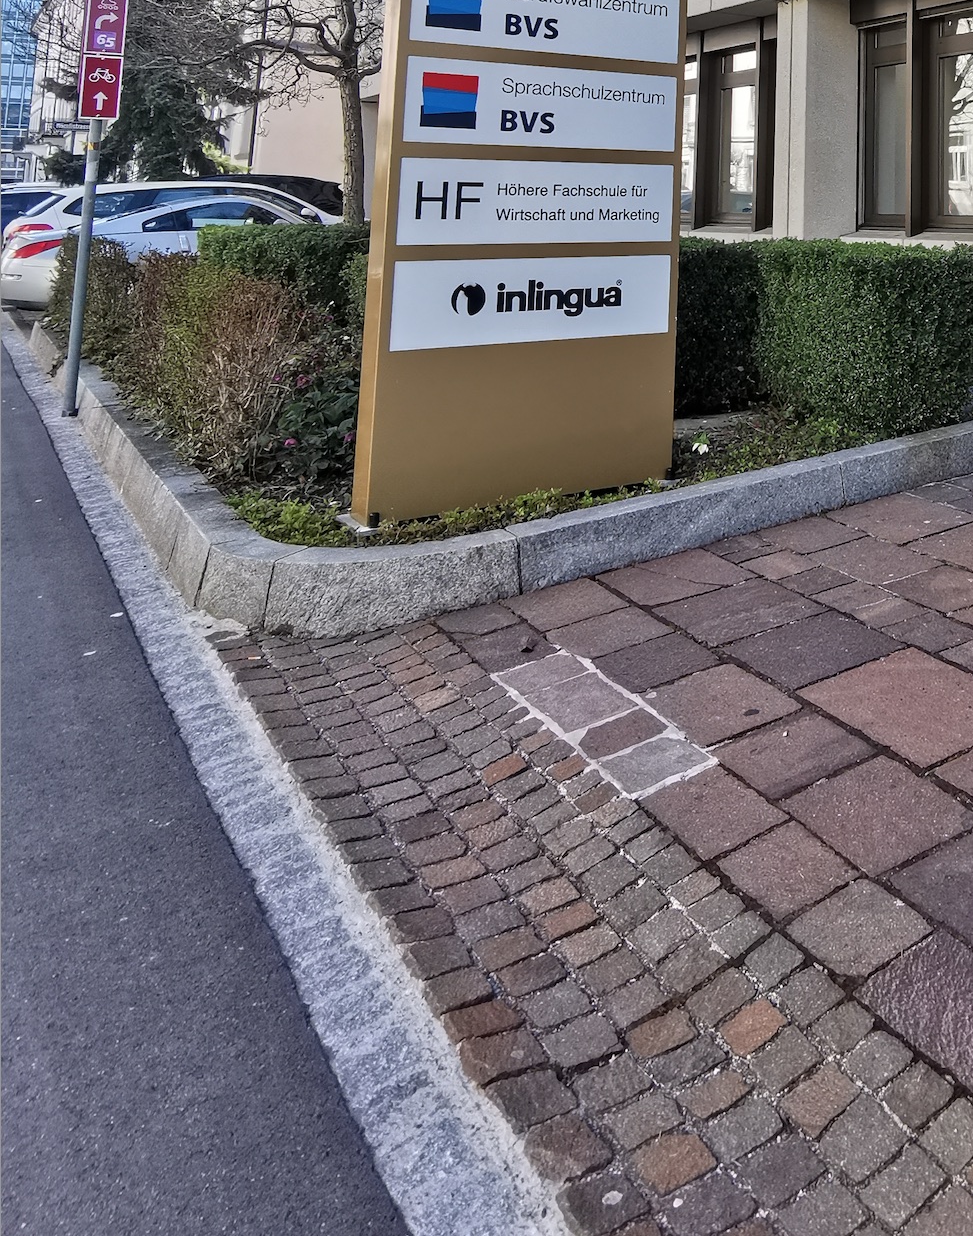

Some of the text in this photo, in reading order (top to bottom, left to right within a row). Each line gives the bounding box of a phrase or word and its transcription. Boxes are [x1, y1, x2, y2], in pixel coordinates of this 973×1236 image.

[504, 13, 560, 41] BVS
[97, 34, 116, 47] 65
[502, 77, 666, 105] Sprachschulzentrum
[499, 109, 556, 134] BVS
[414, 180, 485, 220] HF
[497, 183, 649, 197] Höhere Fachschule für
[495, 208, 660, 223] Wirtschaft und Marketing
[496, 279, 622, 317] inlingua
